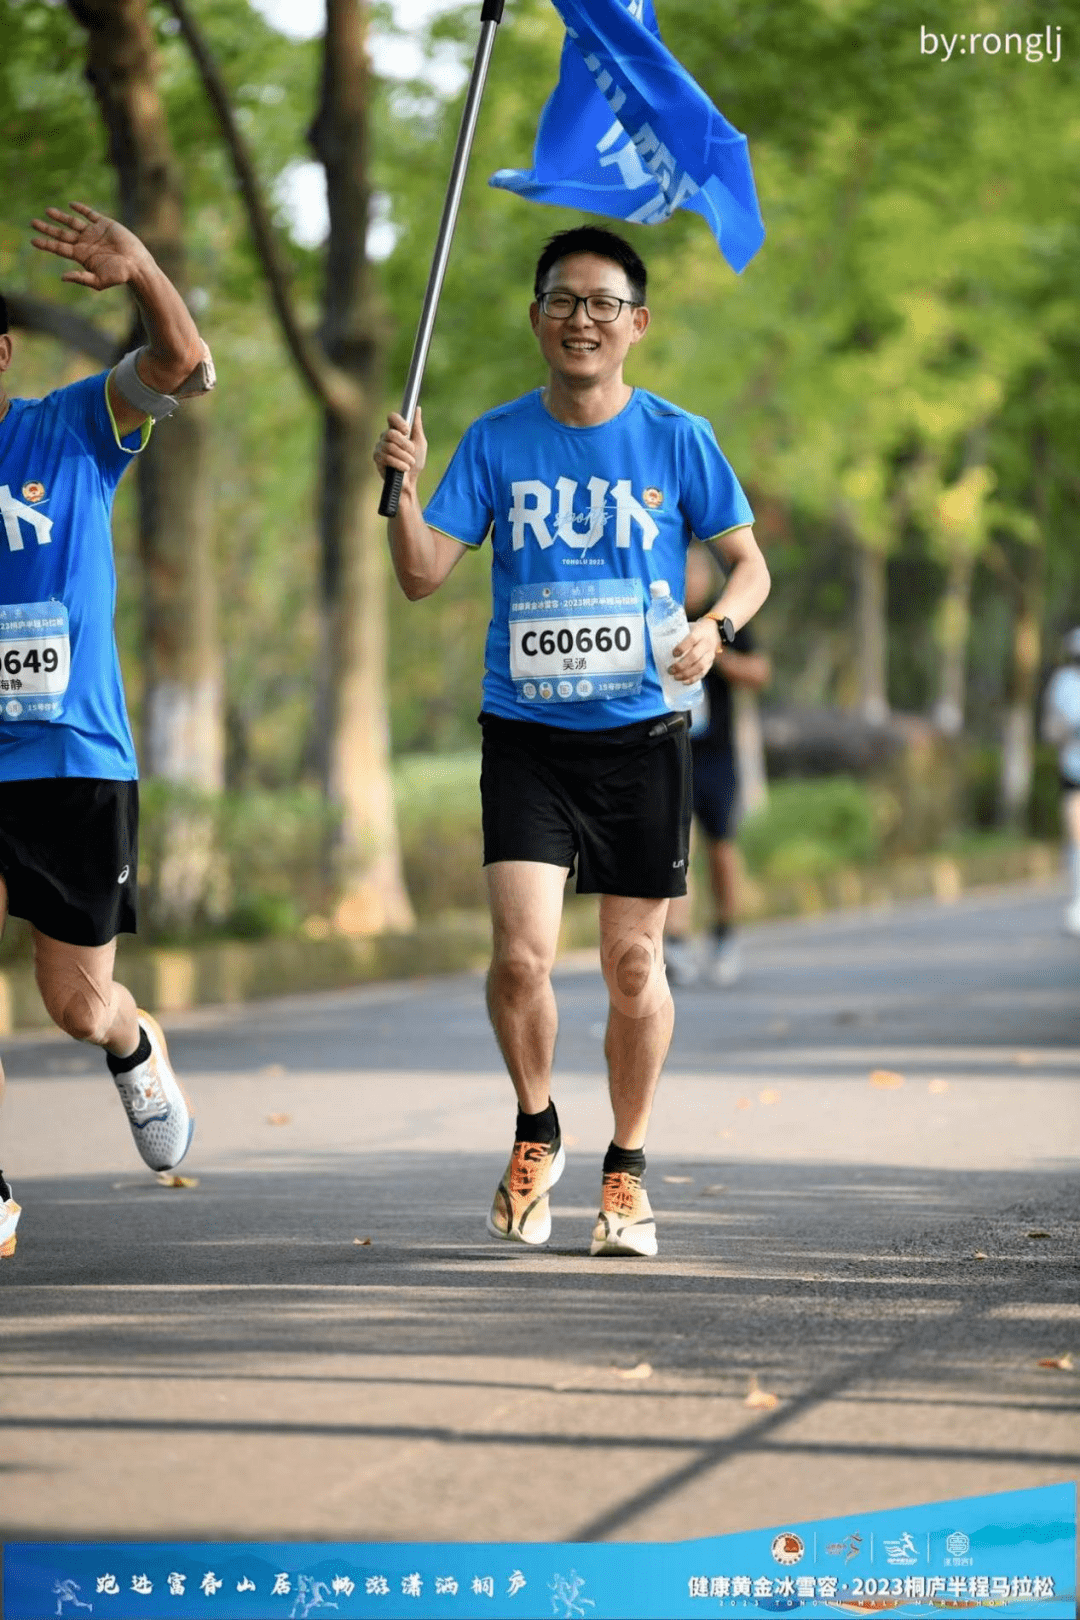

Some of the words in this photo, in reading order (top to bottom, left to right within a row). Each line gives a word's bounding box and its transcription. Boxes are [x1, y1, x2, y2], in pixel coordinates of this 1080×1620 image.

[508, 476, 660, 551] RUN
[520, 626, 632, 657] C60660
[0, 647, 59, 675] 649
